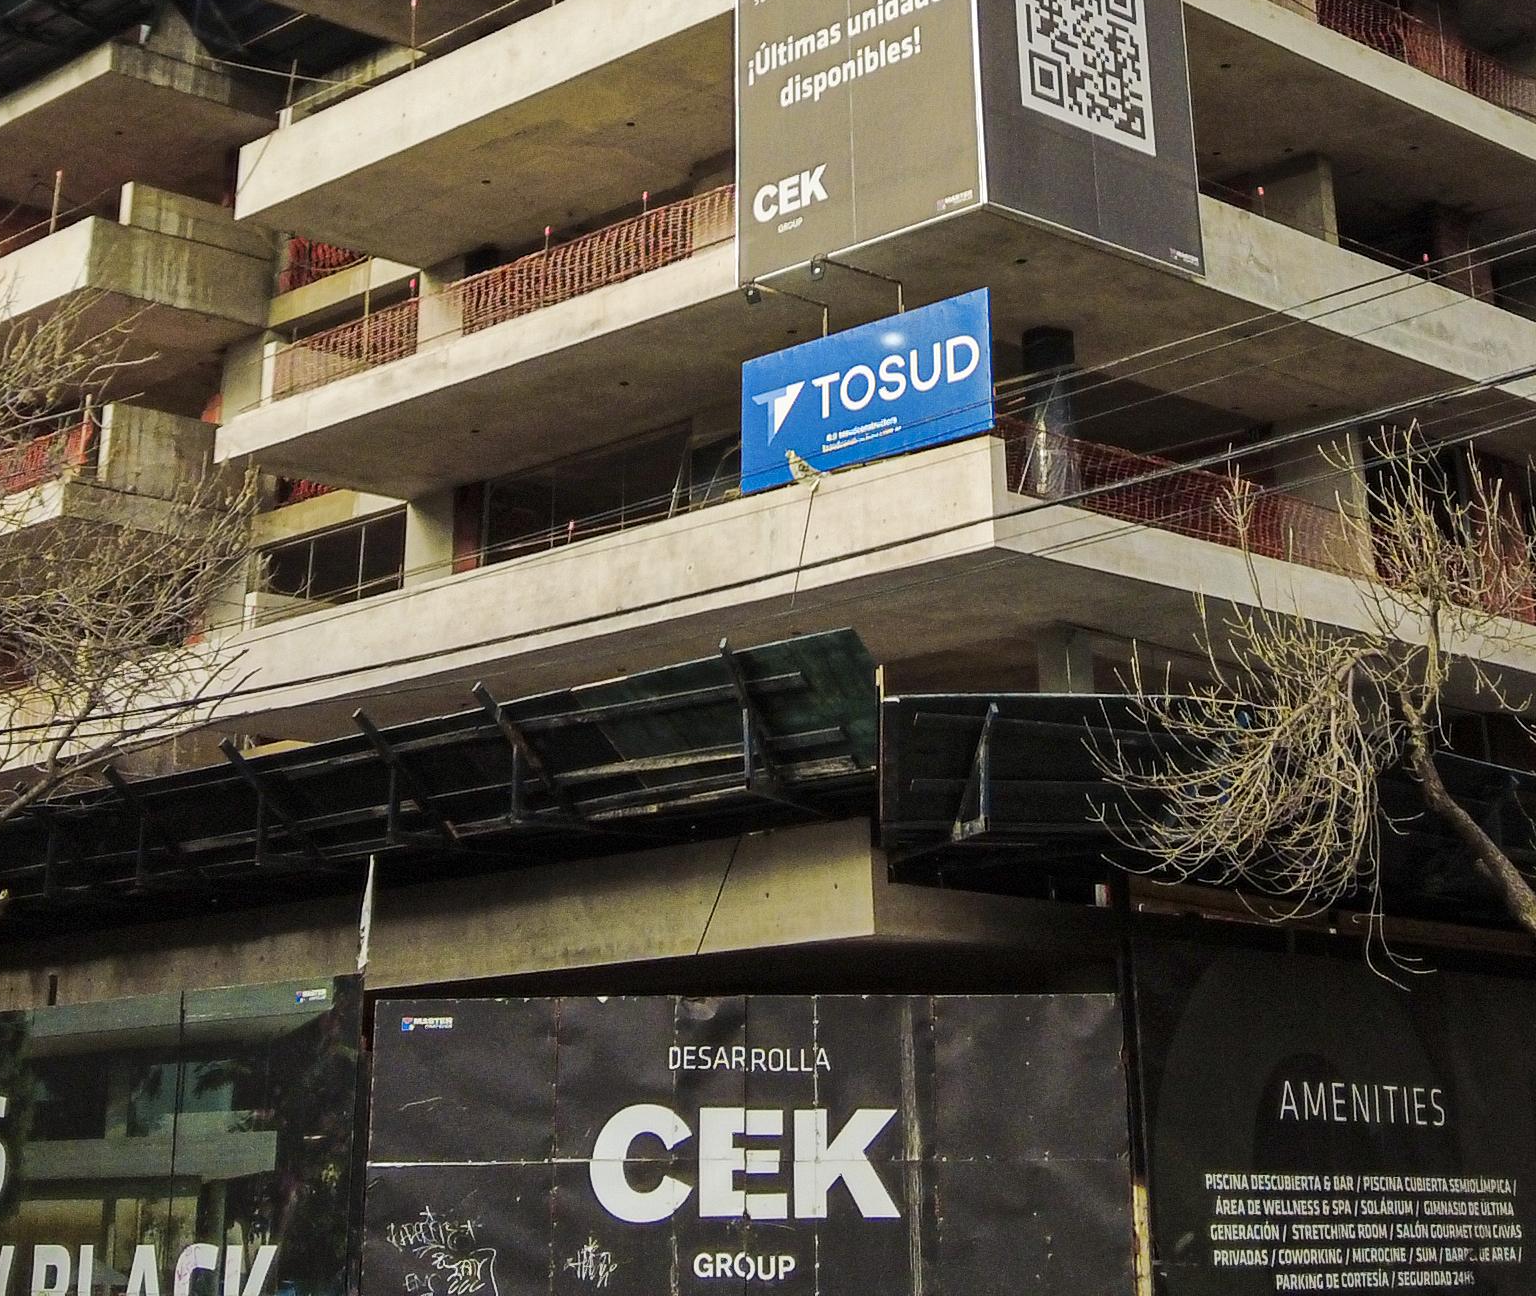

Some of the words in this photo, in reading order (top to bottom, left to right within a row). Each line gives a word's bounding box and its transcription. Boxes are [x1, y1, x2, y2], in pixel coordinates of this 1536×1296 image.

[748, 22, 842, 87] ¡Últimas
[780, 26, 922, 108] disponibles!
[753, 162, 830, 223] CEK
[812, 335, 980, 419] TOSUD
[668, 1046, 831, 1072] DESARROLLA
[1279, 1080, 1445, 1126] AMENITIES
[589, 1103, 901, 1223] CEK
[1205, 1174, 1249, 1190] PISCINA
[1251, 1174, 1322, 1191] DESCUBIERTA
[1333, 1175, 1354, 1191] BAR
[1364, 1176, 1403, 1192] PISCINA
[1405, 1177, 1449, 1193] CUBIERTA
[1449, 1176, 1511, 1194] SEMIOLÍMPICA
[1215, 1196, 1245, 1215] ÁREA
[1247, 1199, 1262, 1215] DE
[1263, 1199, 1320, 1215] WELLNESS
[1332, 1200, 1352, 1215] SPA
[1361, 1196, 1413, 1215] SOLÁRIUM
[1423, 1200, 1467, 1216] GIMNASIO
[1468, 1201, 1480, 1216] DE
[1210, 1221, 1280, 1240] GENERACIÓN
[1292, 1224, 1356, 1240] STRETCHING
[1358, 1224, 1388, 1239] ROOM
[1396, 1220, 1429, 1239] SALÓN
[1430, 1224, 1473, 1239] GOURMET
[1474, 1224, 1492, 1239] CON
[693, 1252, 796, 1281] GROUP
[1214, 1250, 1268, 1266] PRIVADAS
[1278, 1249, 1343, 1265] COWORKING
[1352, 1247, 1407, 1263] MICROCINE
[1416, 1247, 1438, 1263] SUM
[1276, 1274, 1323, 1290] PARKING
[1326, 1274, 1340, 1289] DE
[1341, 1269, 1389, 1288] CORTESÍA
[1397, 1271, 1452, 1286] SEGURIDAD
